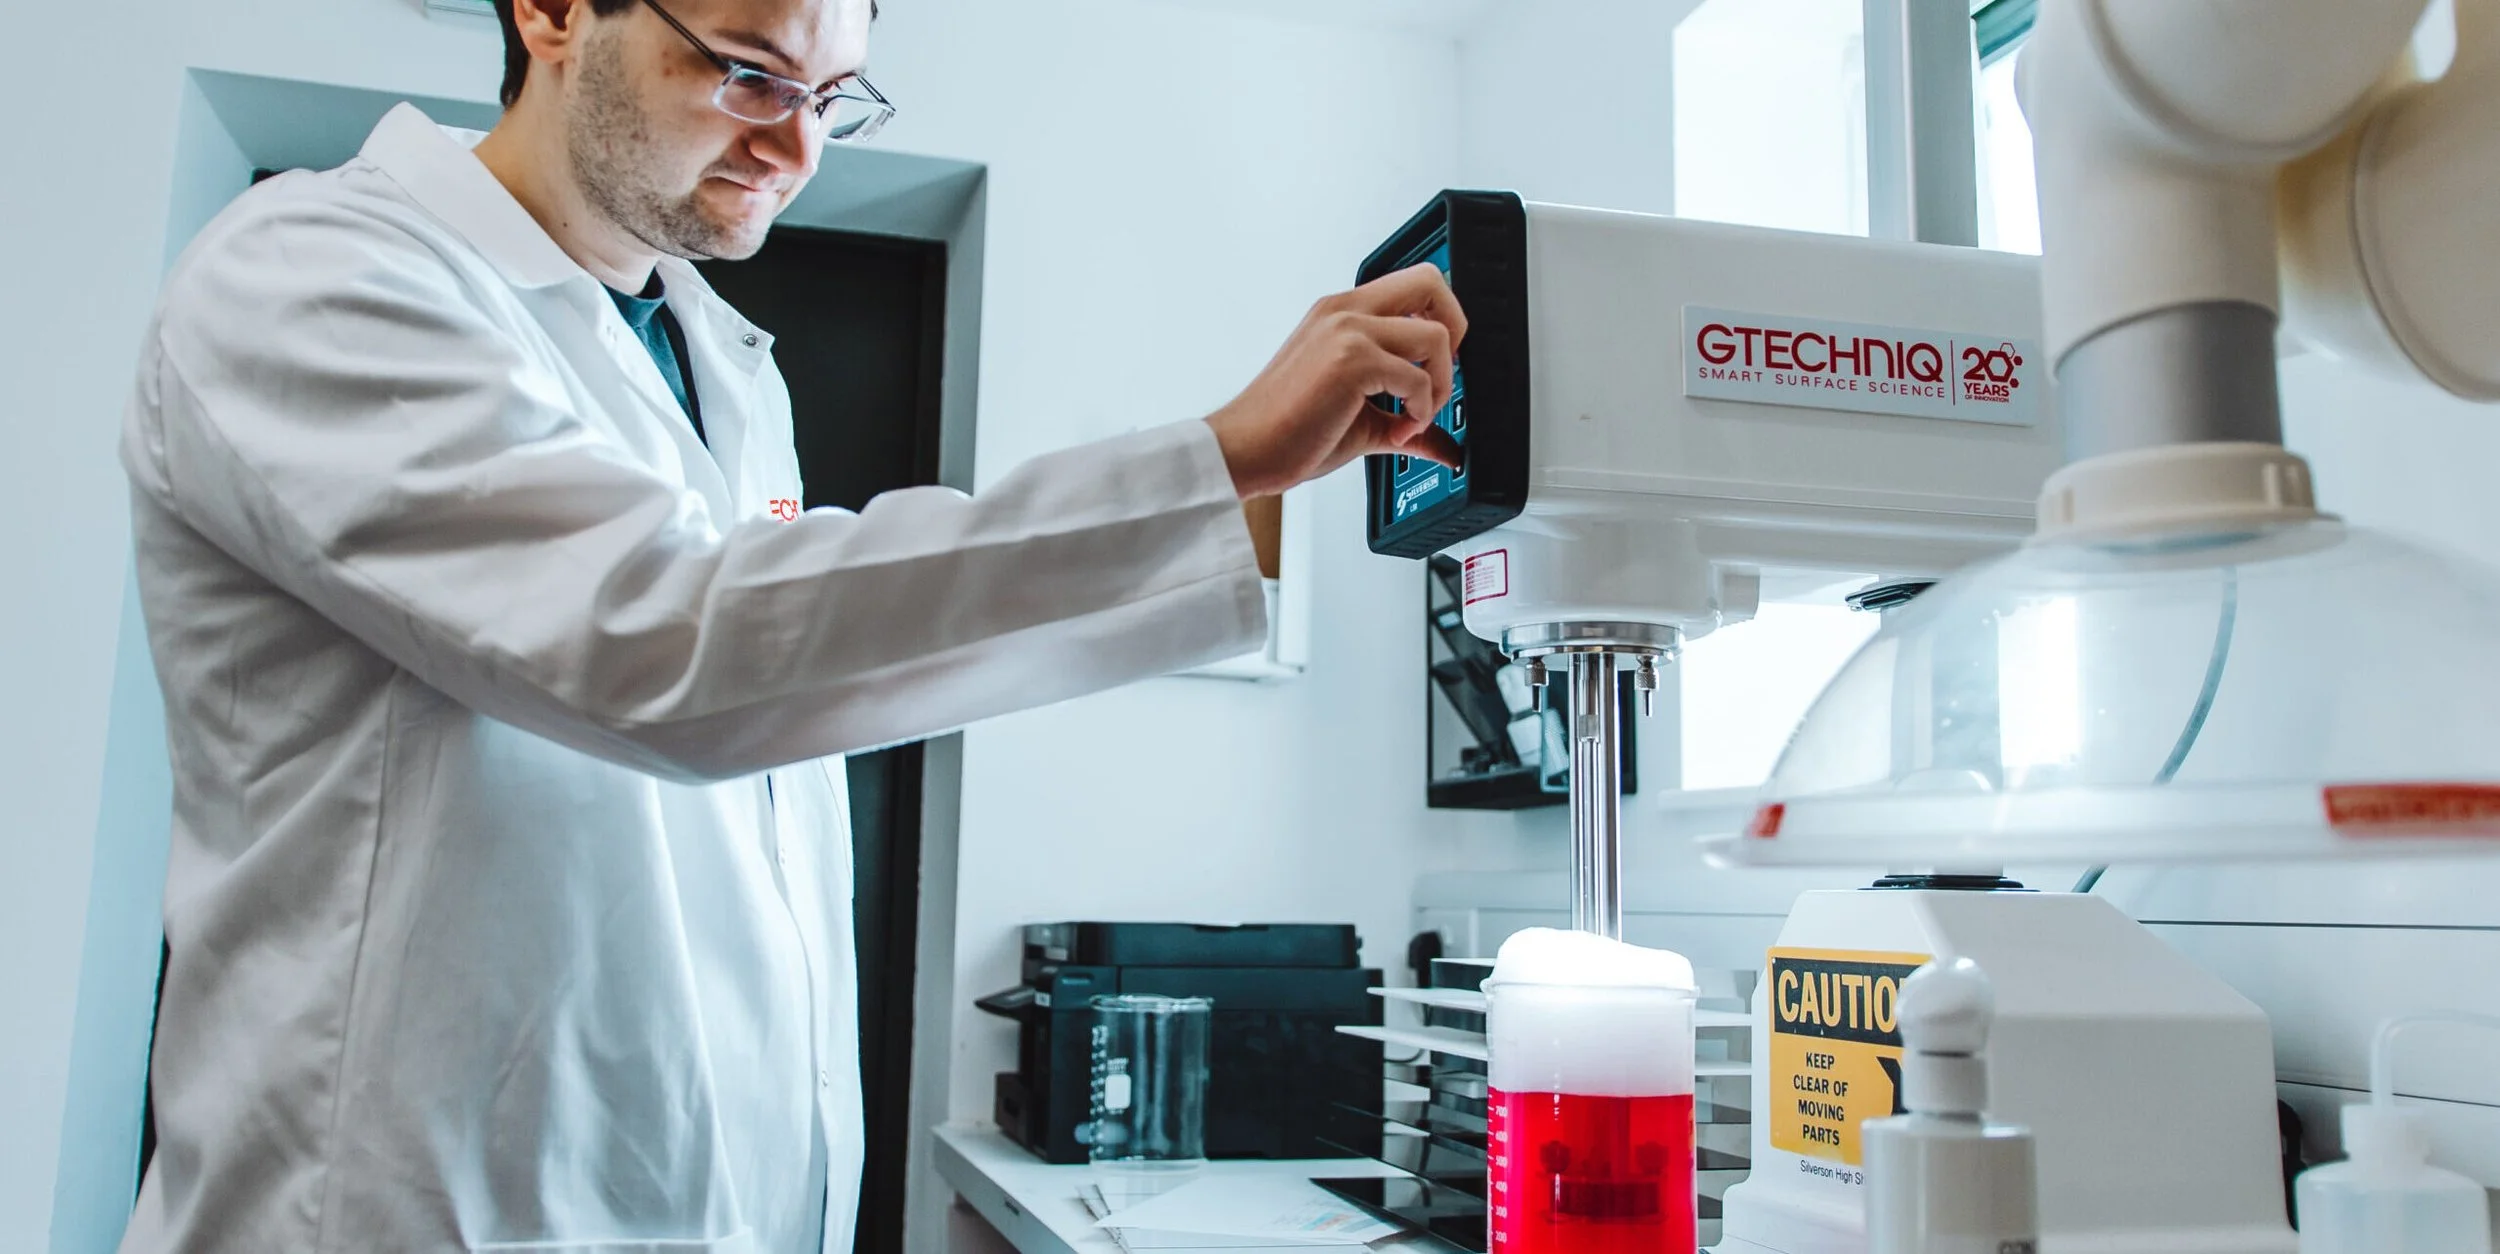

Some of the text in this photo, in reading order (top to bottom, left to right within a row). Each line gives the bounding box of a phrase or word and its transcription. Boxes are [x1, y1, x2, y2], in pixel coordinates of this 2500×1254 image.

[1696, 323, 1944, 383] GTECHNIQ
[1962, 346, 2014, 383] 20
[1698, 366, 1945, 399] SMART SURFACE SCIENCE
[1963, 381, 2010, 397] YEARS
[1974, 395, 2010, 403] INNOVATION
[1777, 969, 1905, 1033] CAUTIO
[1805, 1051, 1835, 1071] KEEP
[1793, 1074, 1848, 1097] CLEAR OF
[1798, 1099, 1845, 1122] MOVING
[1802, 1125, 1840, 1146] PARTS
[1800, 1159, 1833, 1179] Silverson
[1836, 1168, 1853, 1184] High
